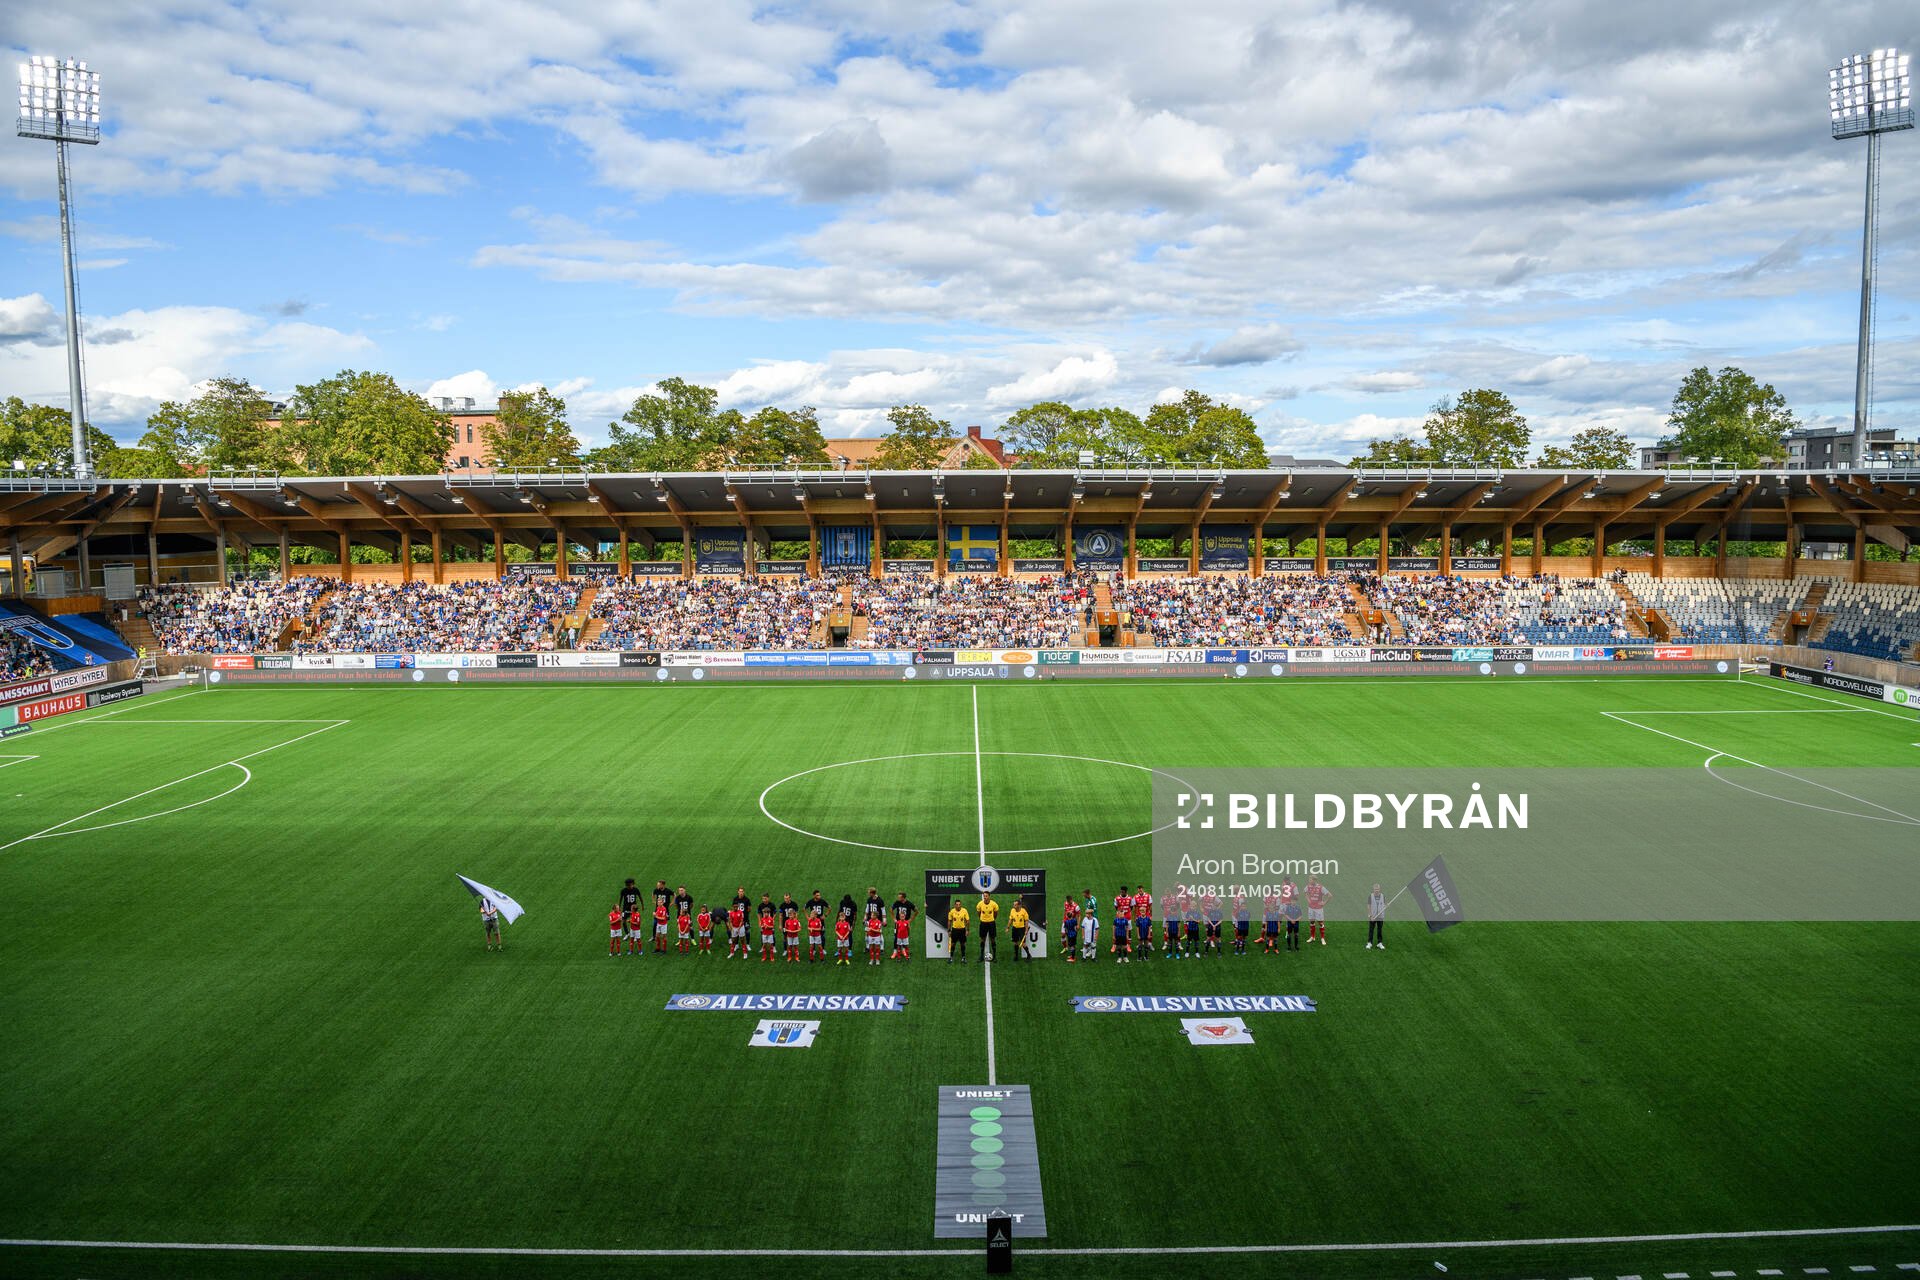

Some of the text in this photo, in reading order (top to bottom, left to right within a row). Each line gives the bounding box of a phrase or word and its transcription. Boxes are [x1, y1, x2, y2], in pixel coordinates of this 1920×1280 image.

[1043, 651, 1073, 660] notar
[1167, 651, 1203, 662] FSAB
[1371, 650, 1411, 660] inkClub
[462, 656, 492, 666] Brixo
[947, 668, 995, 677] UPPSALA
[54, 669, 105, 689] HYREX HYREX
[101, 687, 140, 702] Railway System
[24, 696, 81, 719] BAUHAUS
[1006, 874, 1039, 883] UNIBET
[1425, 868, 1456, 915] UNIBET
[627, 895, 635, 903] 16
[679, 901, 688, 909] 16
[870, 903, 877, 912] 16
[843, 907, 851, 916] 16
[934, 933, 943, 943] U
[1030, 932, 1038, 942] U
[710, 996, 895, 1010] ALLSVENSKAN
[1121, 997, 1306, 1011] ALLSVENSKAN
[956, 1213, 1024, 1223] UNIT
